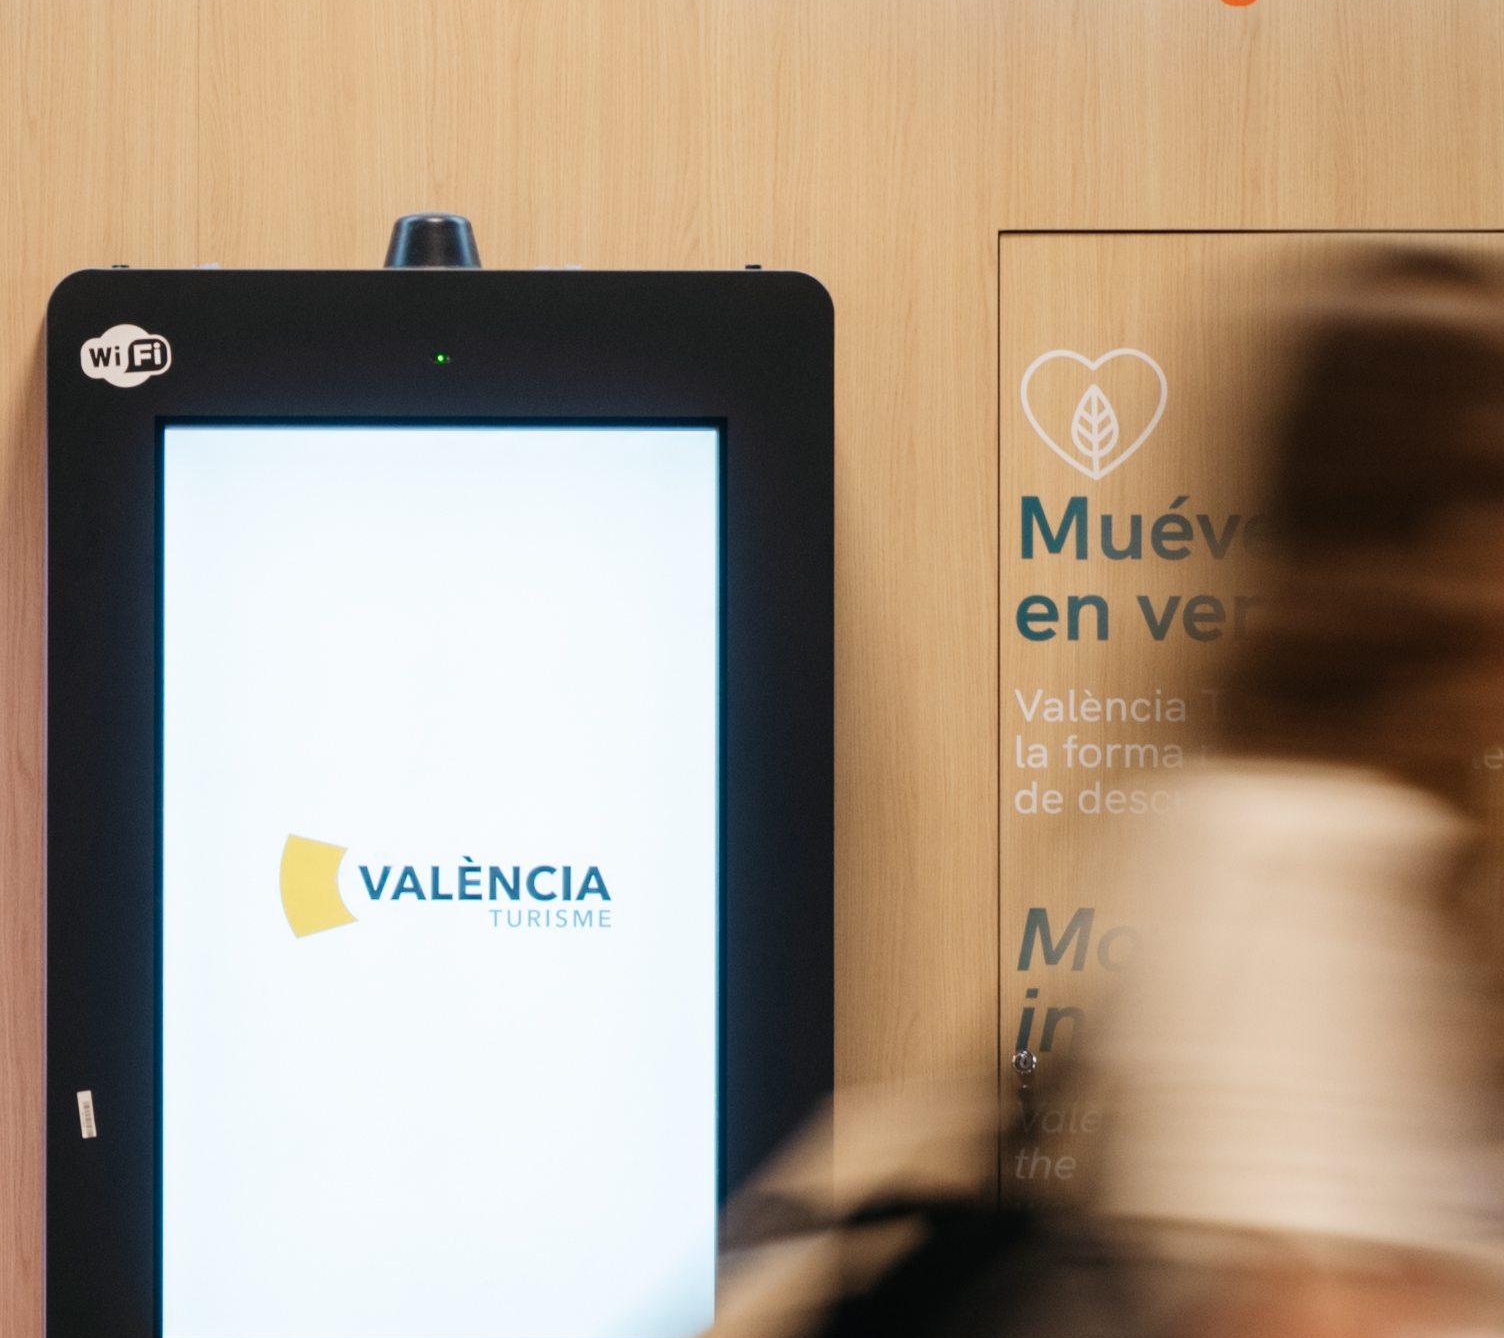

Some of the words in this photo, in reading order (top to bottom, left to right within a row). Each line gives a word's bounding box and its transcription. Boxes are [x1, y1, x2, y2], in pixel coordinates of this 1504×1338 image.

[87, 335, 164, 373] WiFi
[1015, 595, 1109, 642] en
[1013, 689, 1187, 723] València
[1014, 735, 1049, 768] la
[1063, 735, 1184, 768] forma
[1014, 781, 1063, 814] de
[358, 855, 612, 901] VALÈNCIA
[489, 909, 612, 928] TURISME
